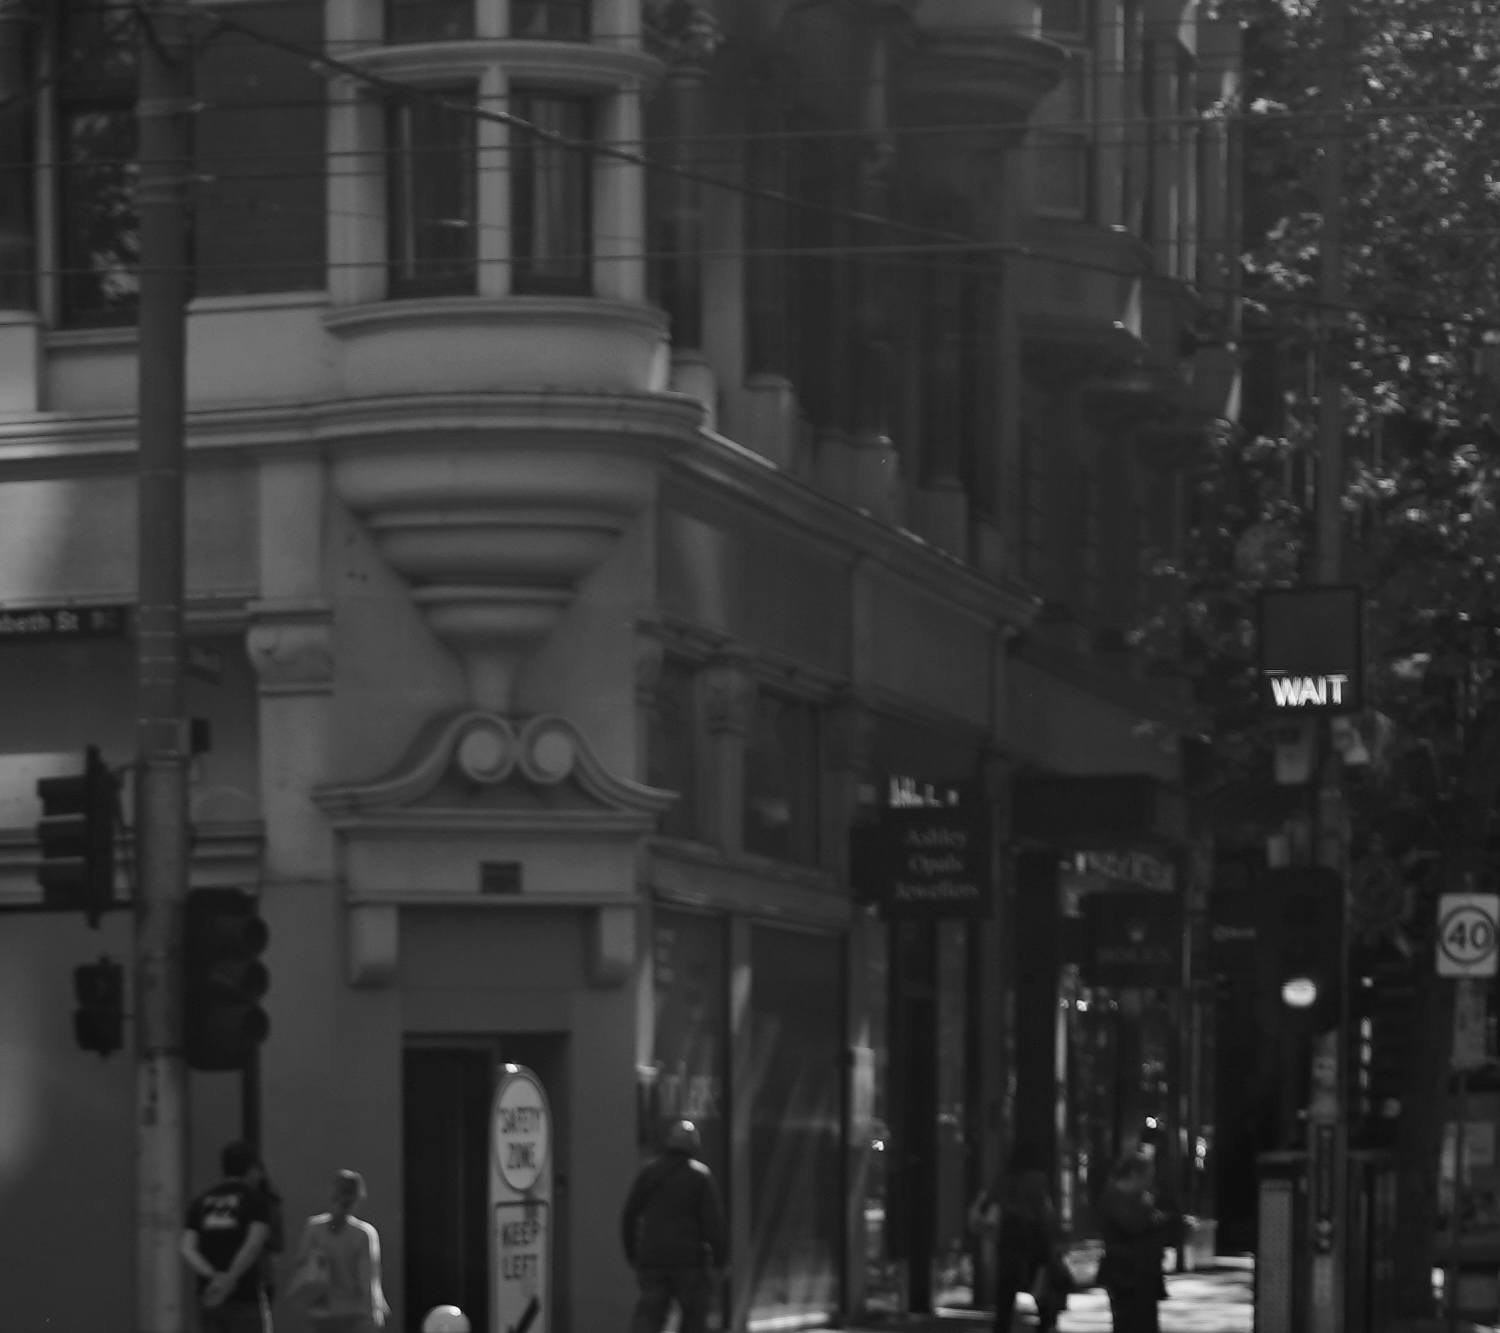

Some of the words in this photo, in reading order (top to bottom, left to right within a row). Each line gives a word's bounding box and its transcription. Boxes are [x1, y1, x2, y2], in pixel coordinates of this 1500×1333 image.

[1270, 674, 1349, 708] WAIT
[1447, 920, 1491, 951] 40
[500, 1105, 541, 1134] SAFETY
[507, 1142, 536, 1170] ZONE
[503, 1220, 539, 1248] KEEP
[504, 1254, 537, 1281] LEFT
